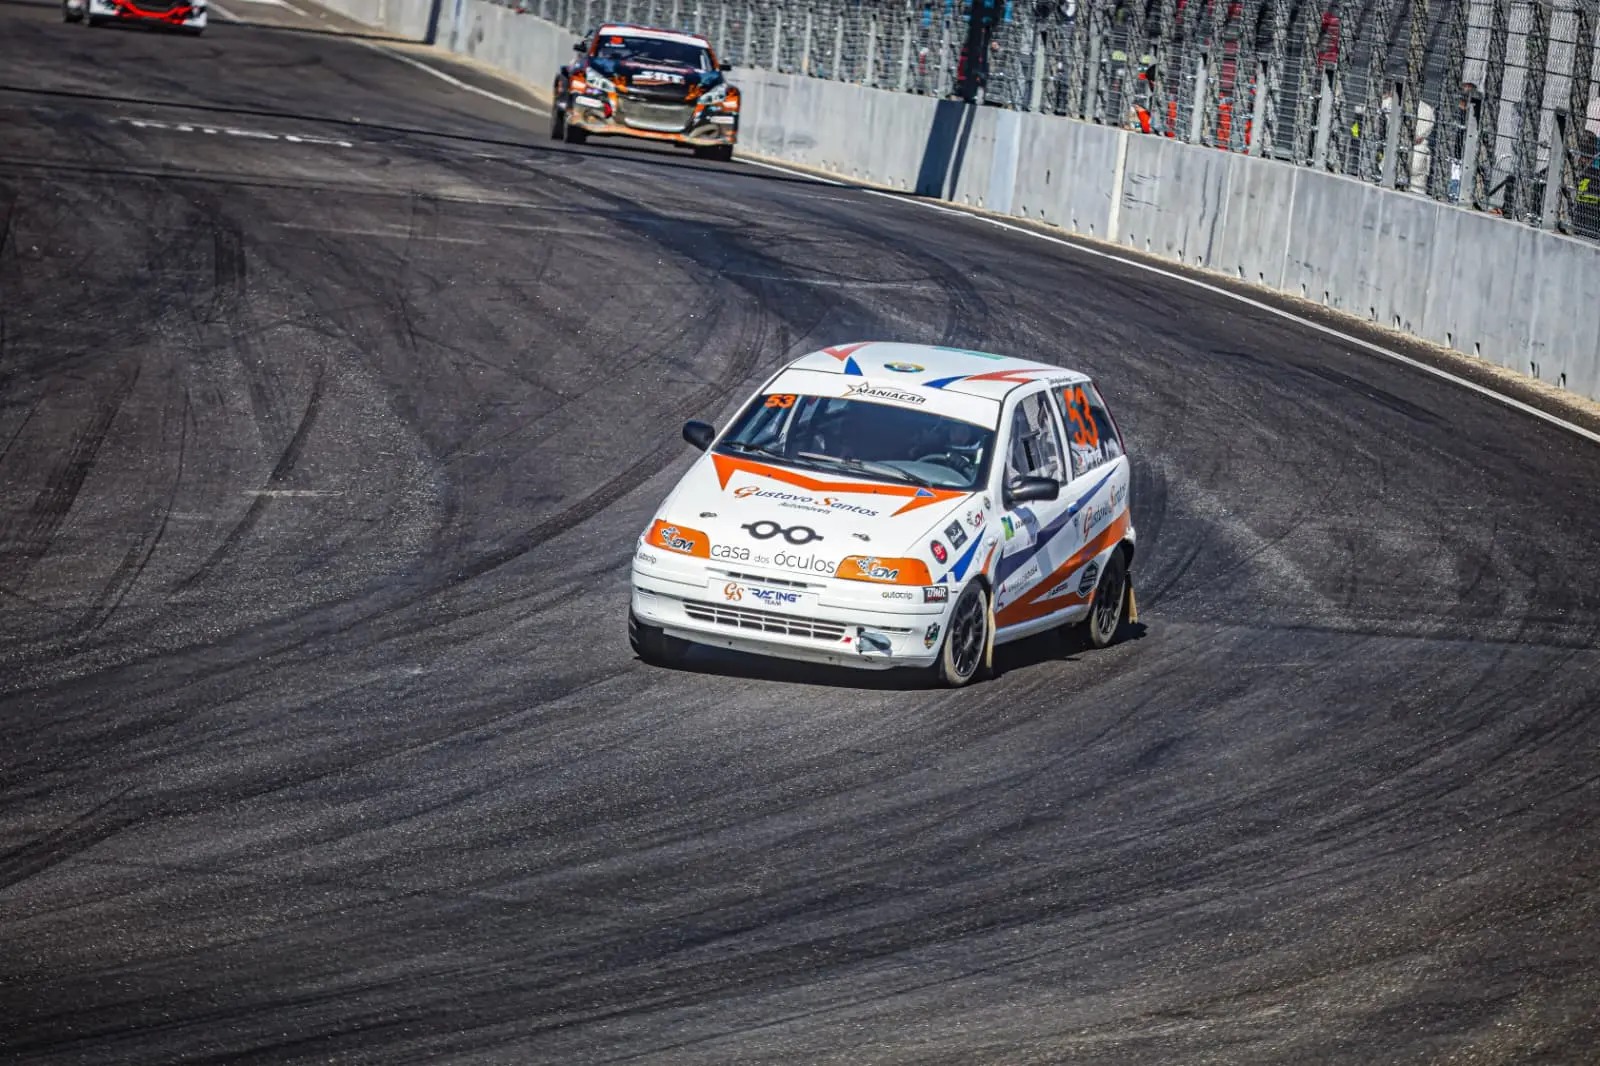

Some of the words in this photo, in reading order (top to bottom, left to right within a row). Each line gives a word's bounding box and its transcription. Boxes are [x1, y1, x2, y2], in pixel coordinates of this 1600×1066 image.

[764, 394, 797, 408] 53
[856, 386, 927, 404] MANIACAR
[1063, 387, 1099, 448] 53
[734, 484, 813, 505] Gustavo
[815, 493, 879, 517] Santos
[711, 541, 750, 561] casa
[753, 555, 770, 564] dos
[774, 551, 836, 574] óculos
[723, 582, 745, 602] GS
[747, 587, 803, 603] RACING
